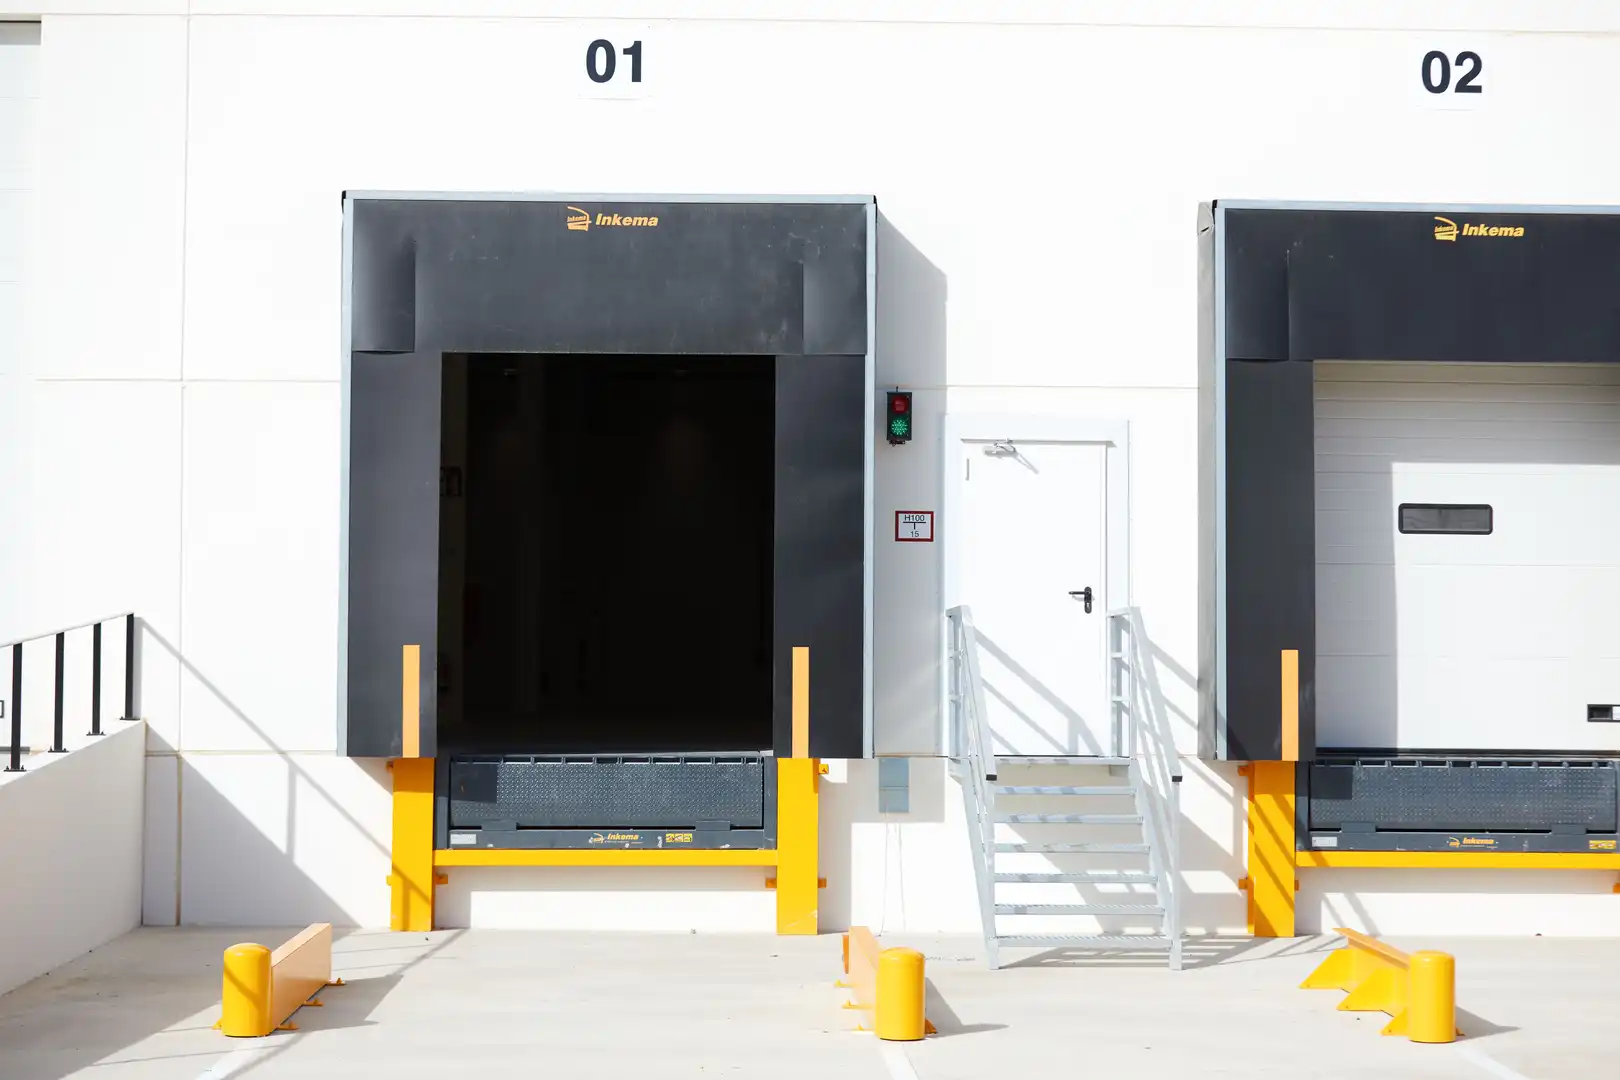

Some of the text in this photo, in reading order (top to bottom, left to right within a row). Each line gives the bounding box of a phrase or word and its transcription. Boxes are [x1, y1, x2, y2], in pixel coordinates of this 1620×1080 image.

[586, 39, 642, 83] 01
[1421, 50, 1482, 94] 02
[595, 213, 659, 227] Inkema
[1462, 223, 1525, 237] Inkema
[904, 514, 925, 522] H100
[910, 530, 920, 538] 15
